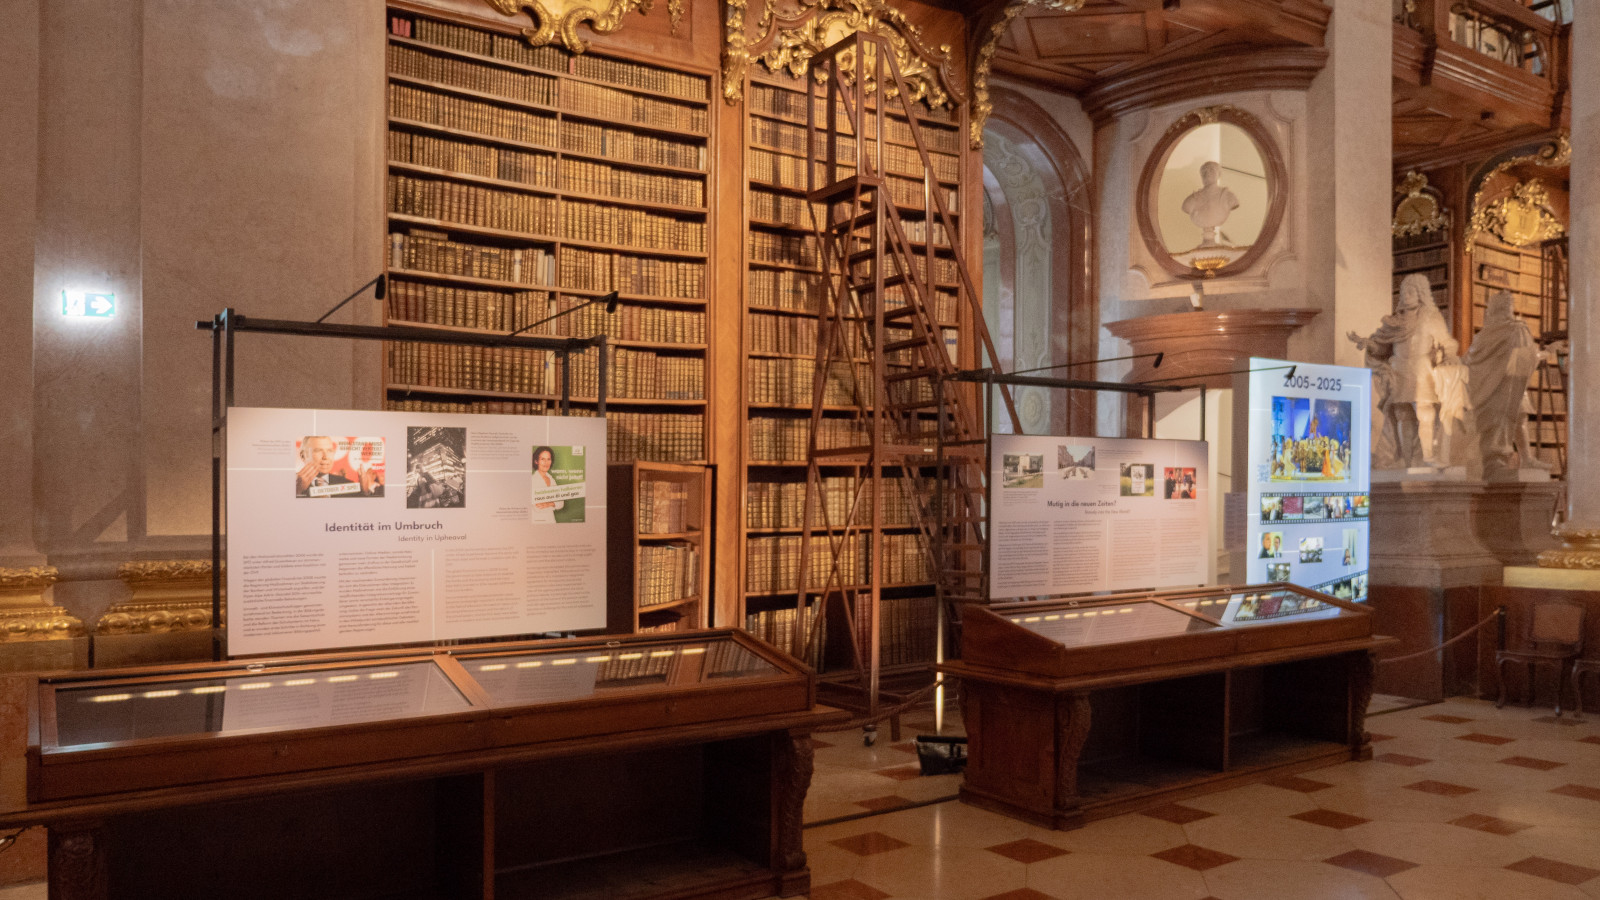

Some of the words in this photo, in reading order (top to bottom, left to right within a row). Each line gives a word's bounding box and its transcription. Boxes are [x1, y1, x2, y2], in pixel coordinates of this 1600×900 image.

[1047, 500, 1064, 508] Mutig
[325, 522, 375, 532] Identität
[378, 521, 392, 531] im
[394, 521, 443, 531] Umbruch
[398, 534, 425, 542] Identity
[434, 533, 467, 542] Upheaval
